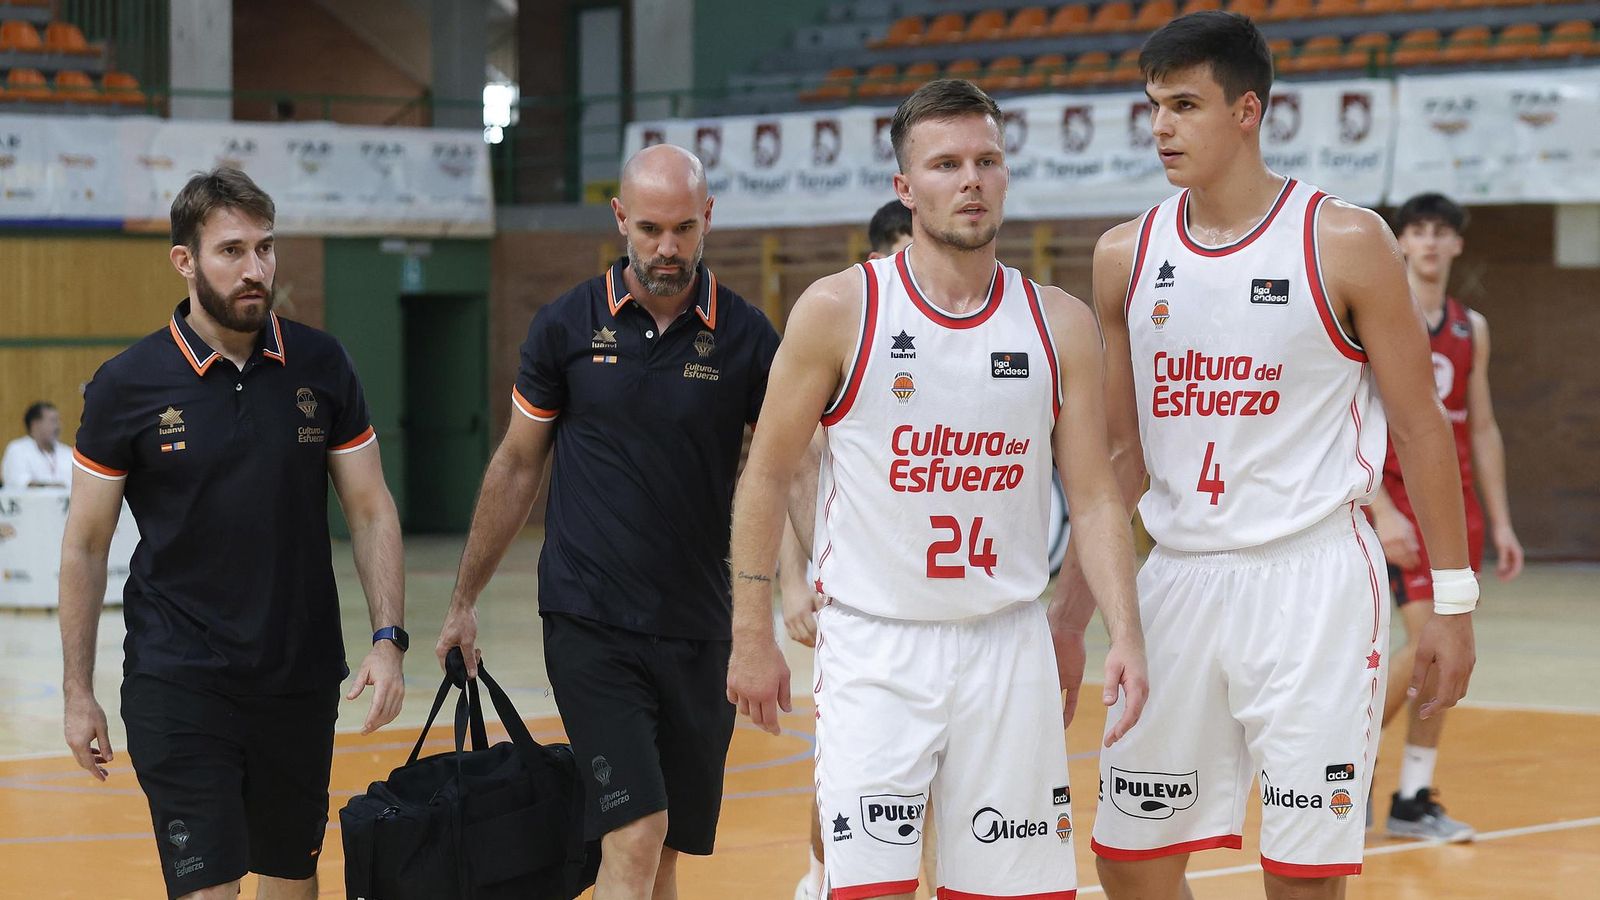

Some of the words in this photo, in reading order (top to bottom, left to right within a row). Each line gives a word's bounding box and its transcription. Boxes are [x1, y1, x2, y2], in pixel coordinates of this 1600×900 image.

[1253, 285, 1270, 295] liga
[1253, 293, 1288, 302] endesa
[890, 351, 917, 359] luanvi
[684, 362, 713, 374] Cultura
[993, 359, 1010, 369] liga
[1153, 350, 1253, 383] Cultura
[1254, 363, 1283, 381] del
[683, 369, 719, 381] Esfuerzo
[994, 367, 1028, 376] endesa
[1152, 383, 1281, 418] Esfuerzo
[159, 426, 186, 435] luanvi
[891, 424, 1006, 457] Cultura
[1005, 438, 1030, 455] del
[889, 458, 1024, 493] Esfuerzo
[1196, 441, 1225, 506] 4
[926, 514, 998, 579] 24
[1327, 770, 1349, 781] acb
[1115, 776, 1193, 799] PULEVA
[1054, 793, 1068, 804] acb
[1261, 784, 1323, 809] Midea
[981, 818, 1048, 840] Midea
